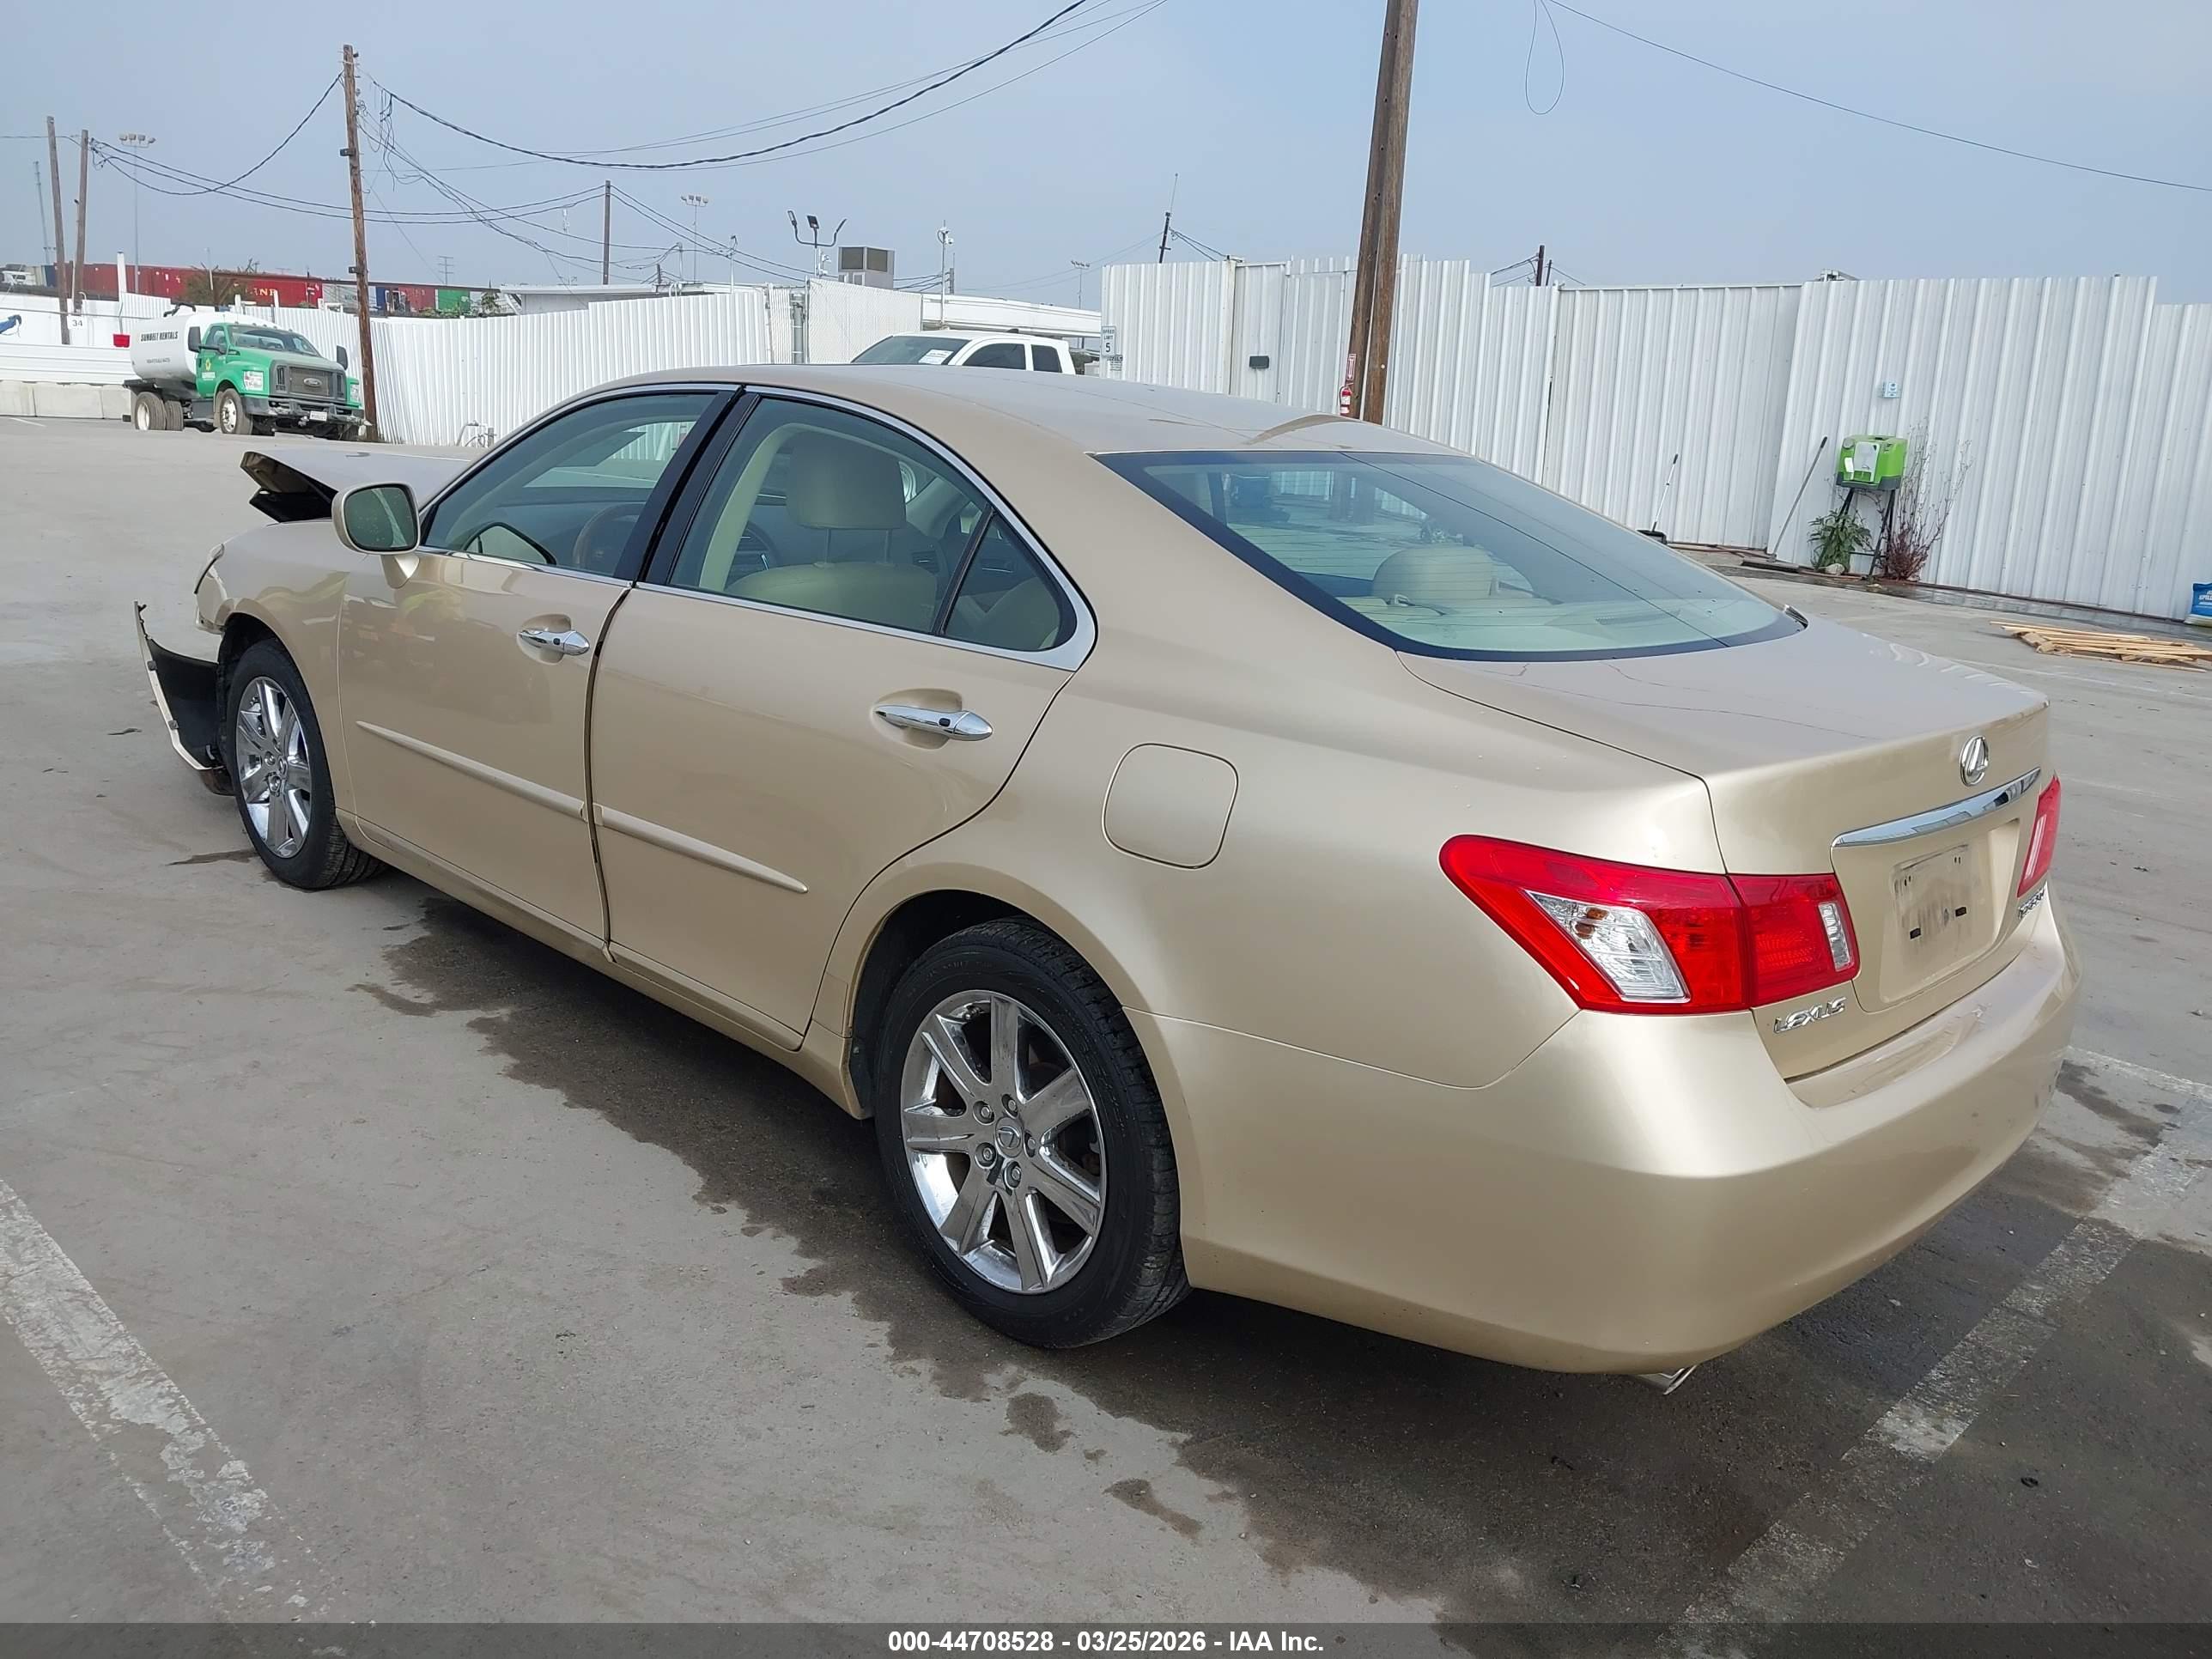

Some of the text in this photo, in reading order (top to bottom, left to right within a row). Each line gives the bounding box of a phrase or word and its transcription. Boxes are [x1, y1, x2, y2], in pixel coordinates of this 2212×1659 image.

[71, 319, 83, 327] 34
[141, 331, 178, 342] SUNBELT RENTALS
[1105, 342, 1111, 353] 5
[1773, 996, 1846, 1034] LEXUS
